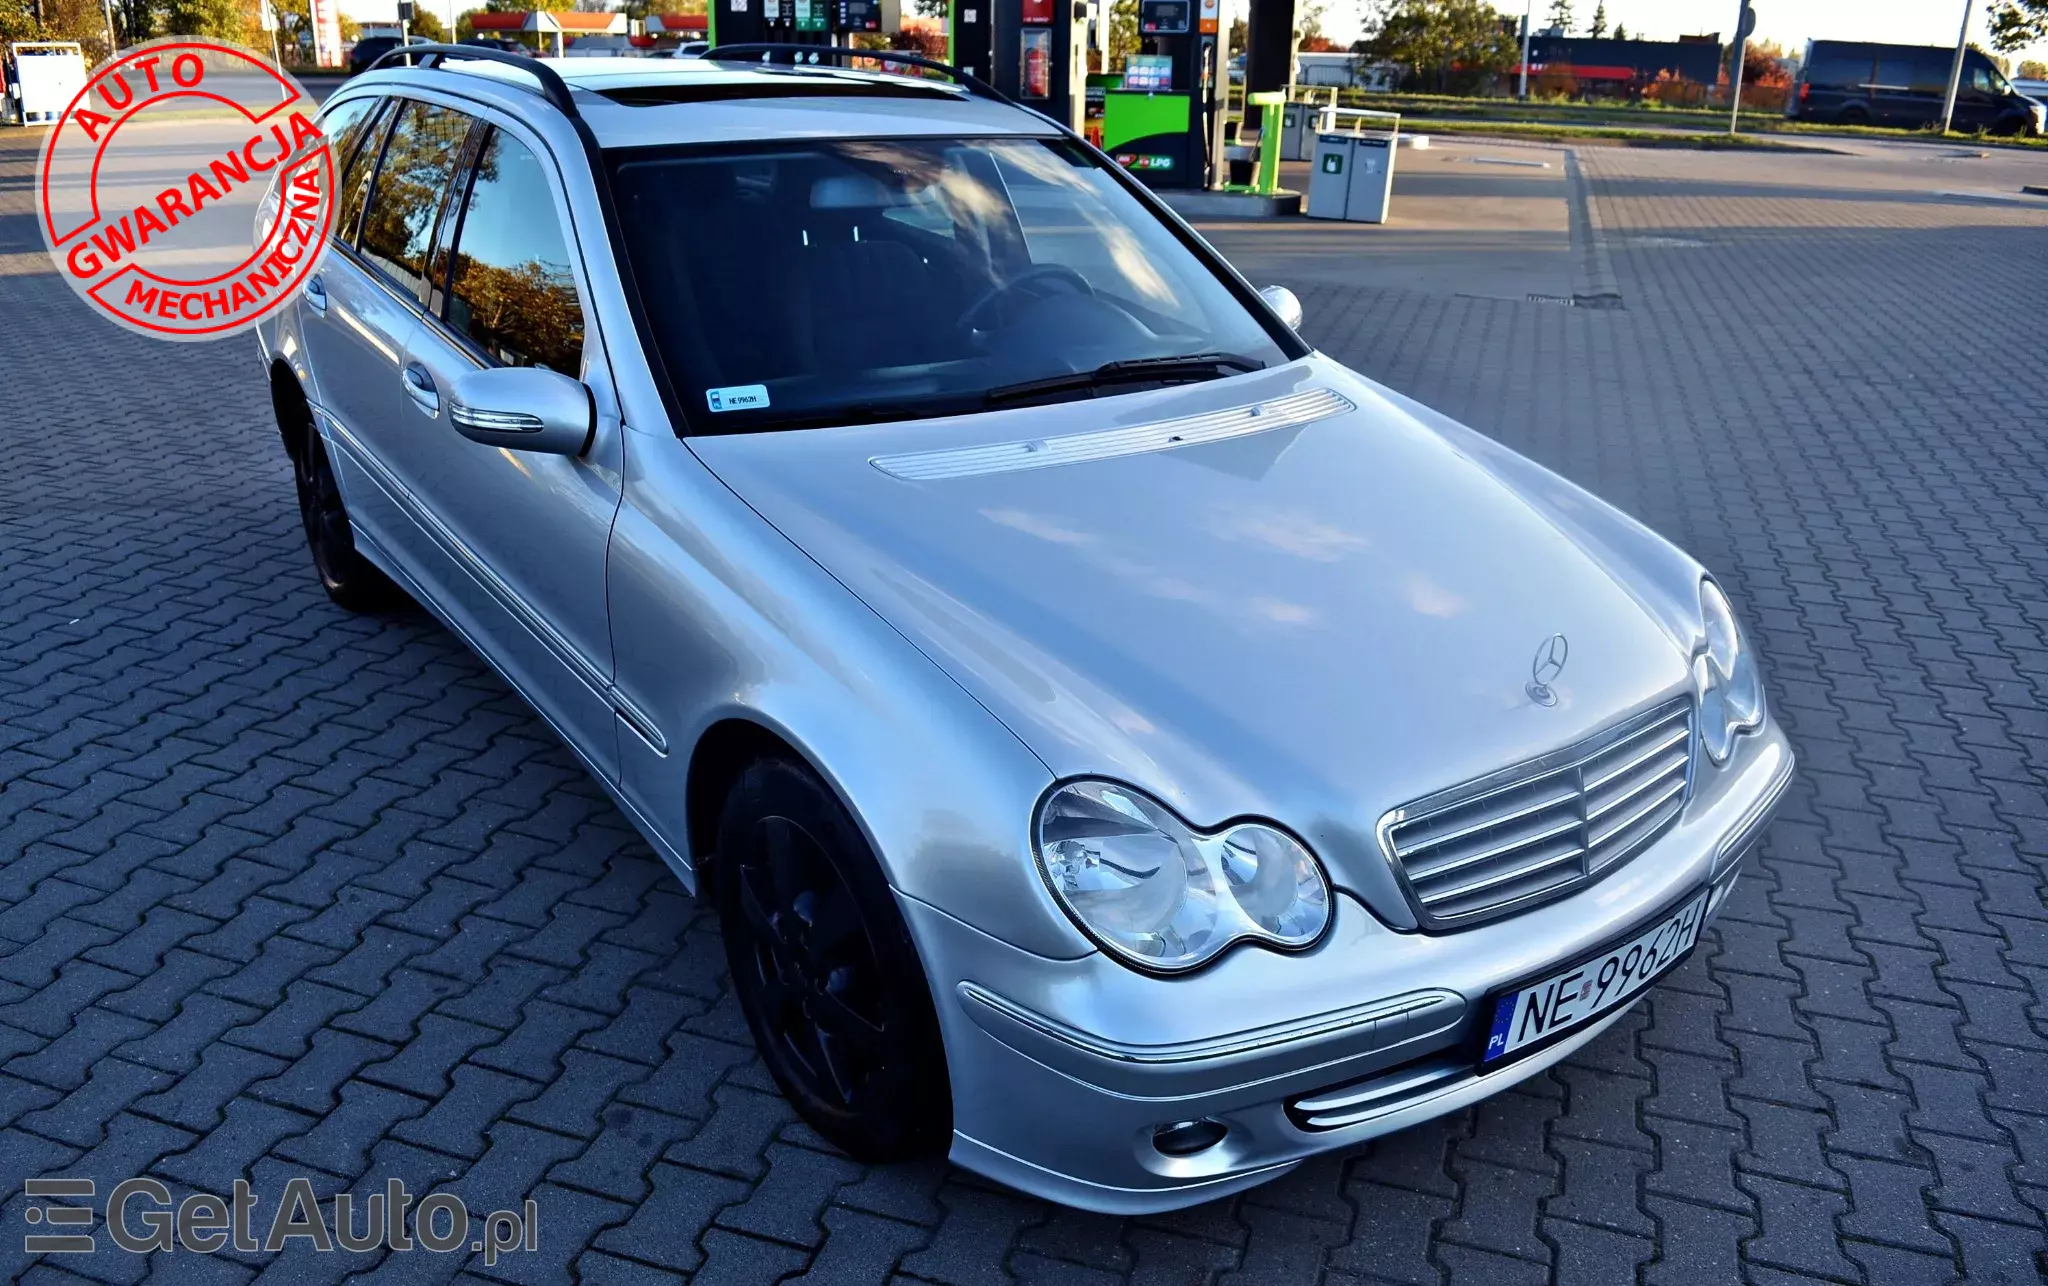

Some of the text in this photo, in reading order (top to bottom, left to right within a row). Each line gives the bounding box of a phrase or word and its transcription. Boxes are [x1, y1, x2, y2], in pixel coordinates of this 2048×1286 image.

[1150, 157, 1171, 168] LPG
[1517, 899, 1702, 1043] NE 9962H
[1488, 1032, 1505, 1050] PL
